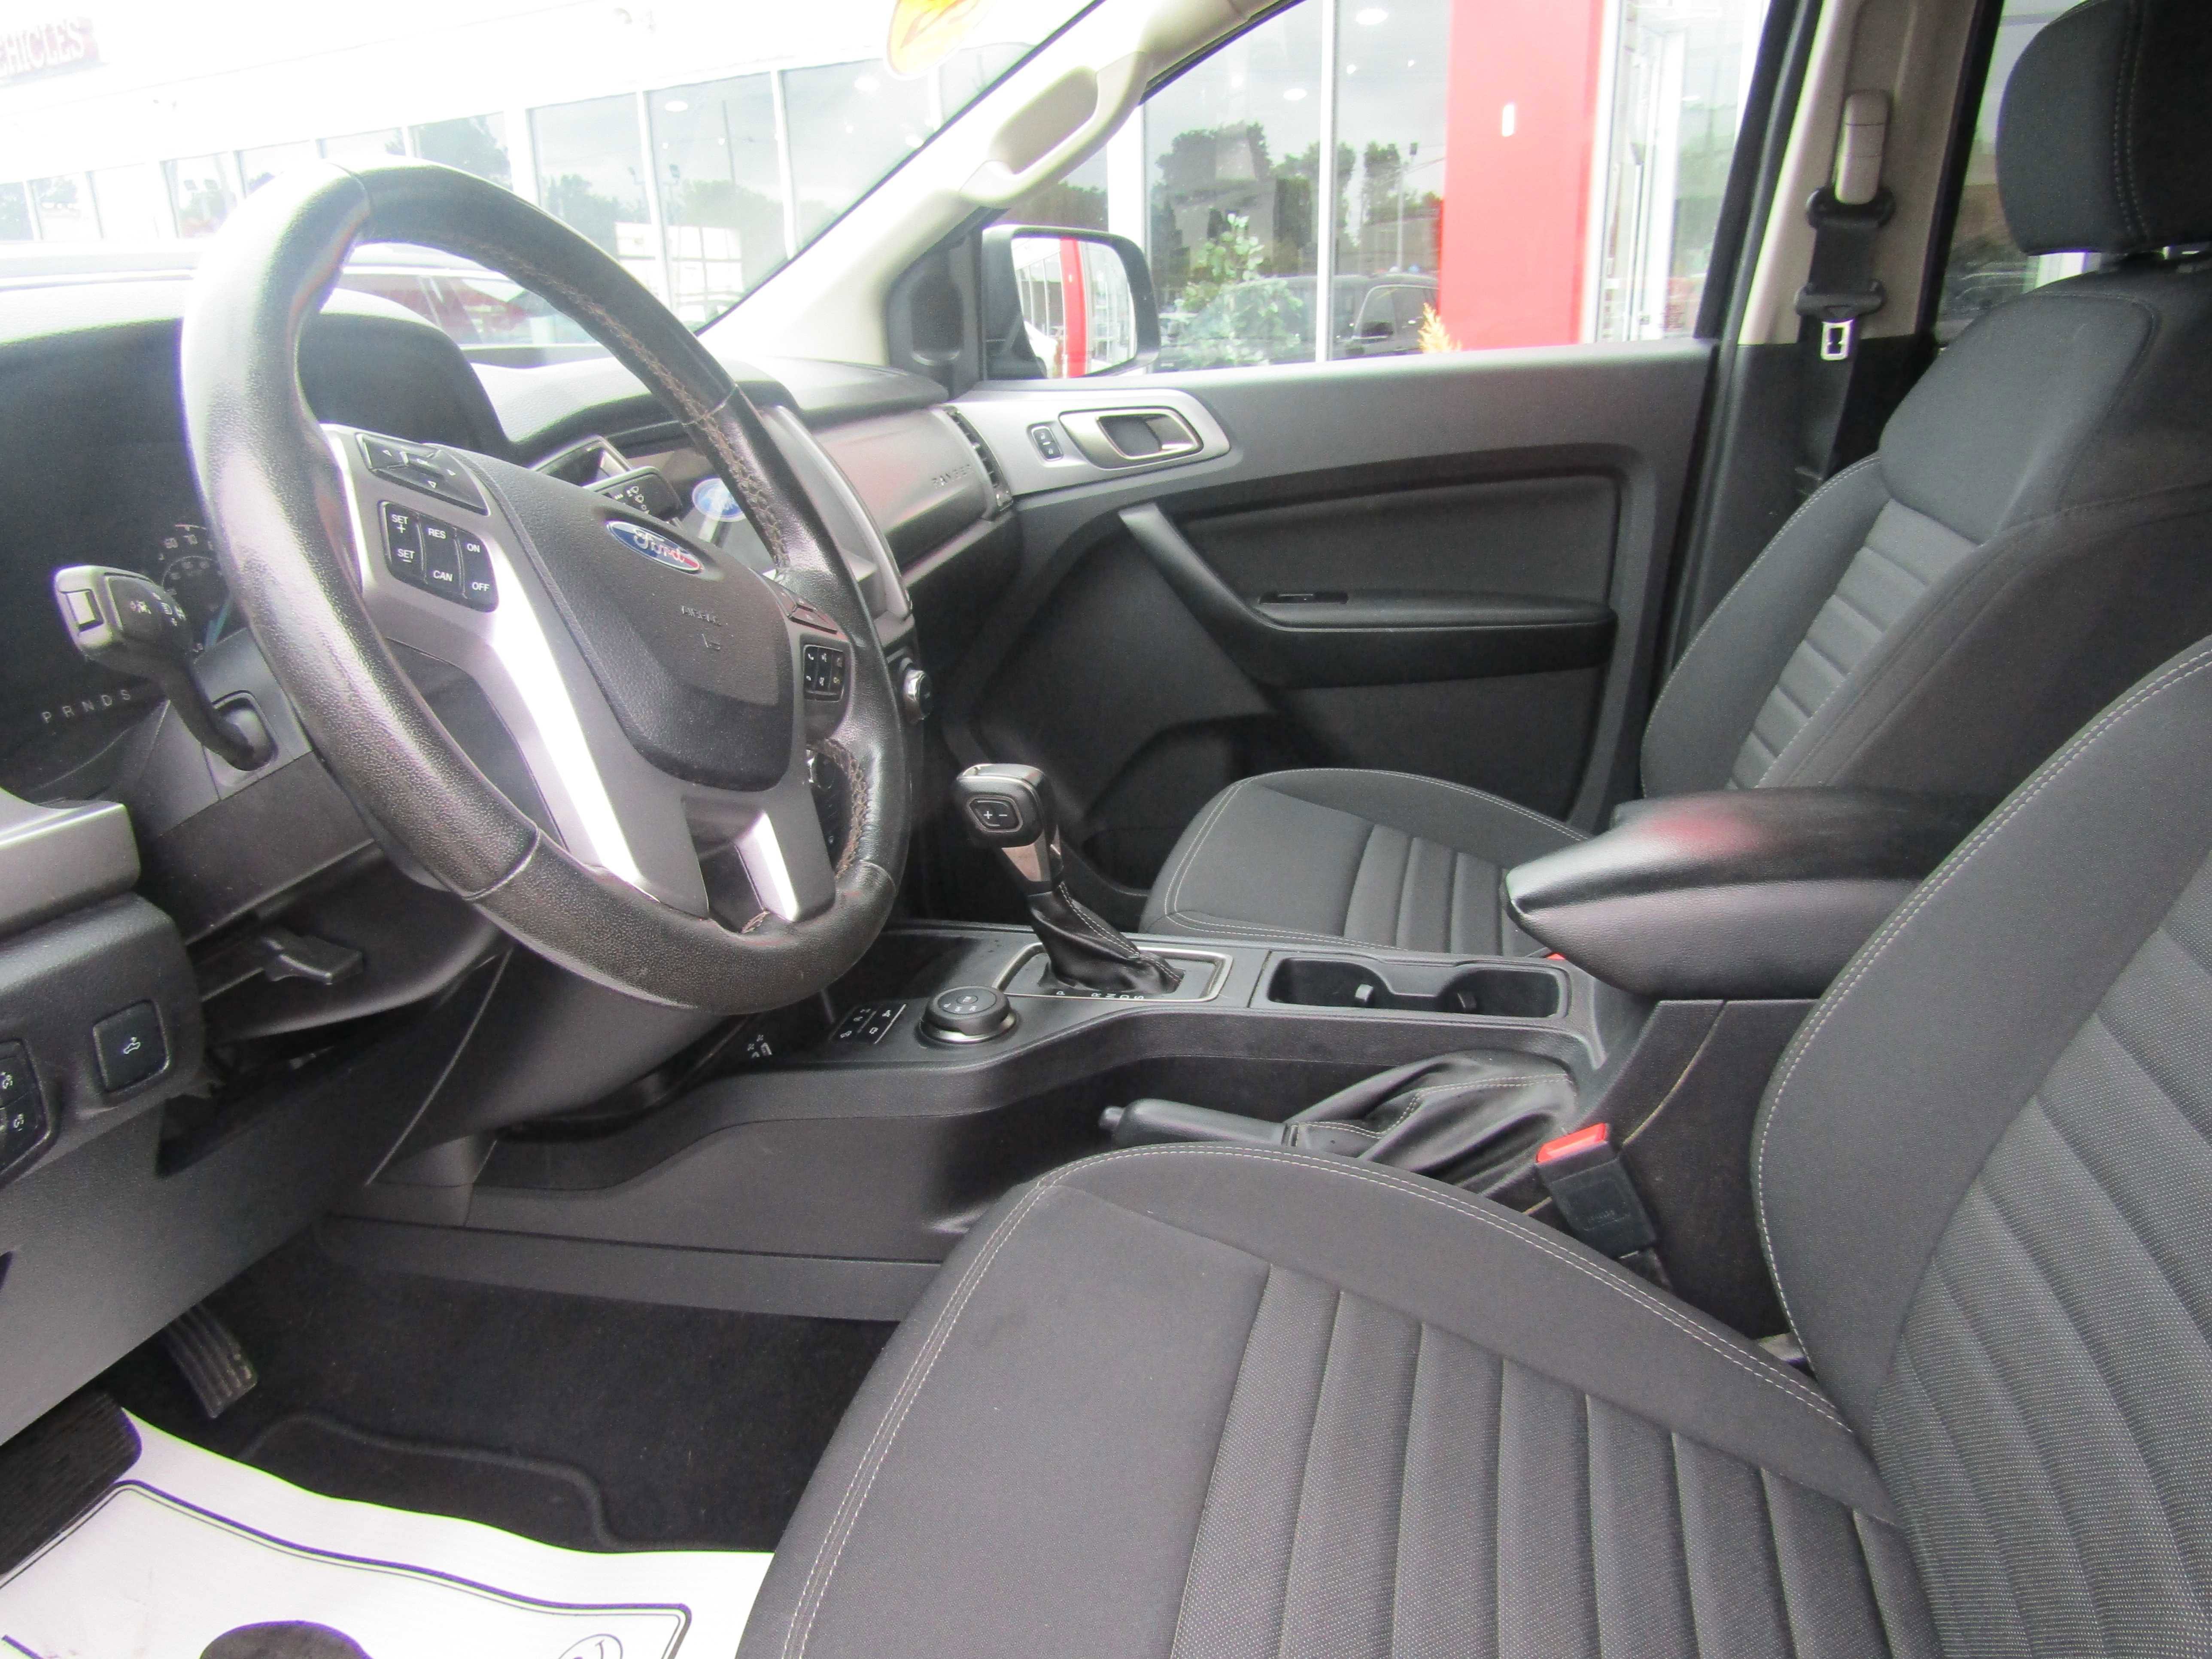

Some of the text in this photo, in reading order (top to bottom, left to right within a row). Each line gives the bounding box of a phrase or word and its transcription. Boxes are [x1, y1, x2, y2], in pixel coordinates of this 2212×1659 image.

[392, 515, 408, 524] SET
[428, 528, 446, 539] RES
[467, 544, 480, 553] ON
[633, 528, 685, 563] Ford
[398, 549, 415, 559] SET
[433, 571, 453, 581] CAN
[472, 582, 489, 591] OFF
[42, 711, 52, 723] P
[63, 706, 75, 718] R
[102, 695, 112, 706] D
[121, 690, 131, 700] S
